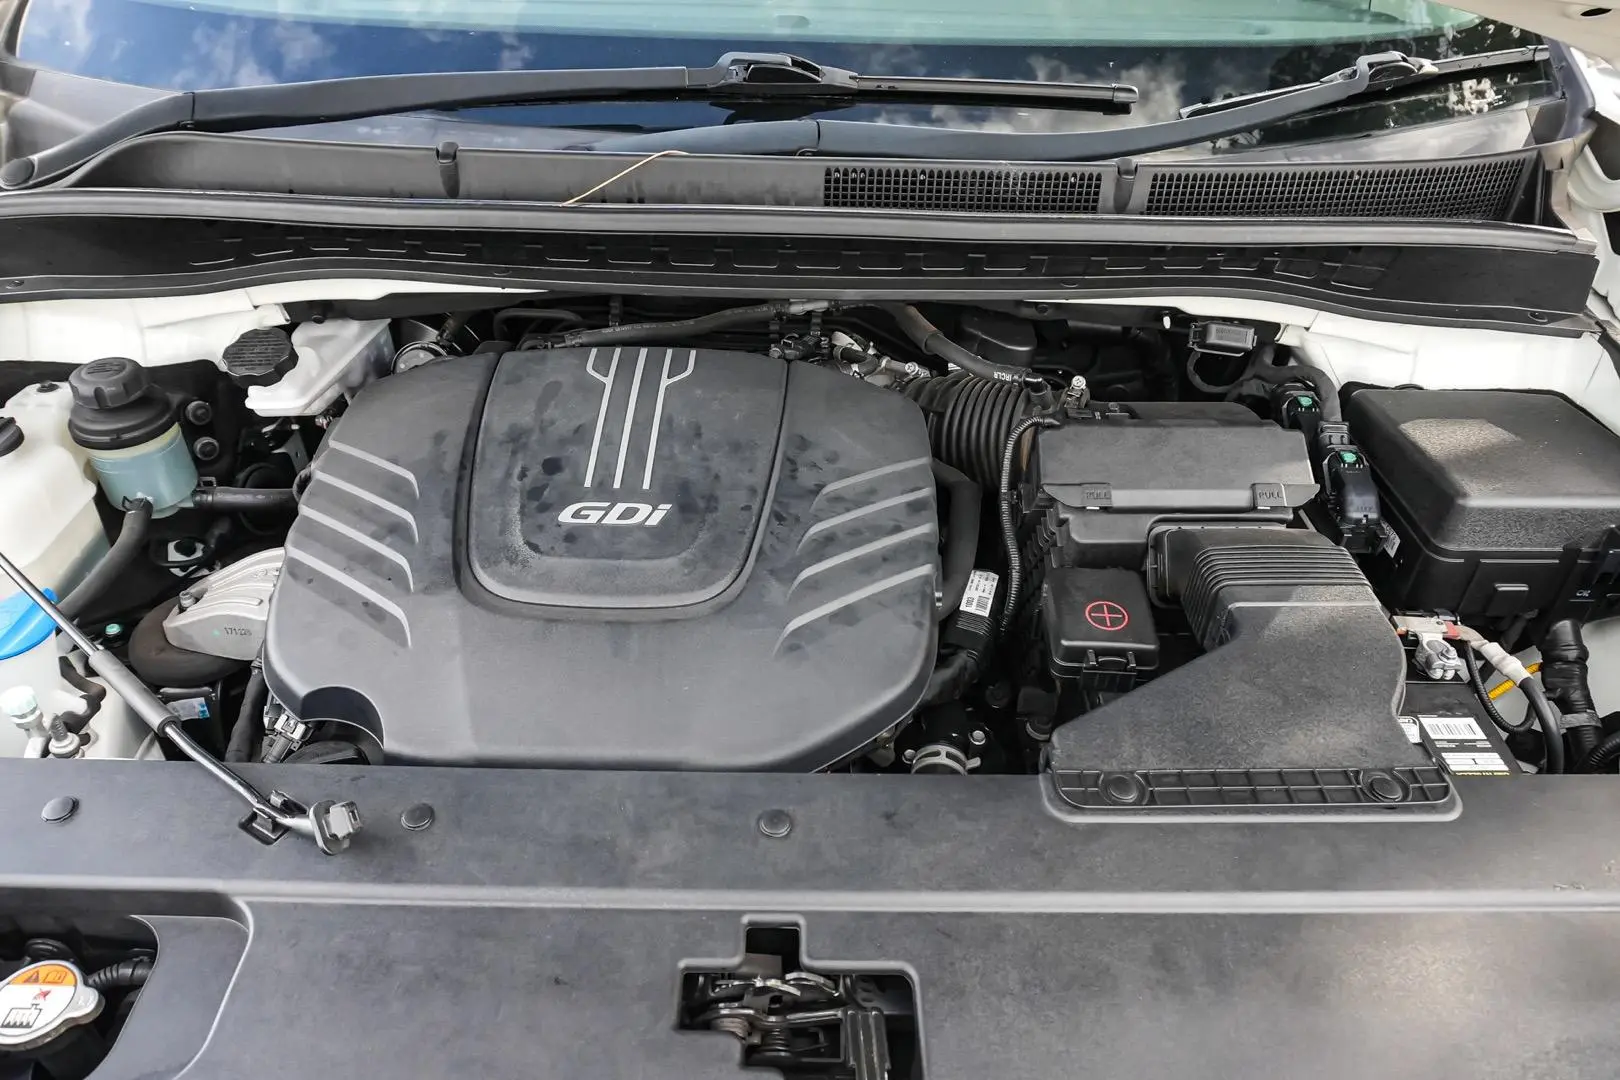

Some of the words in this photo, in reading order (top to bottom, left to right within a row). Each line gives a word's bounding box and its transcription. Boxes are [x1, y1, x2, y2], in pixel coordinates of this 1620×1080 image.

[1086, 491, 1109, 499] PULL
[1258, 491, 1283, 499] PULL
[558, 501, 673, 526] GDi
